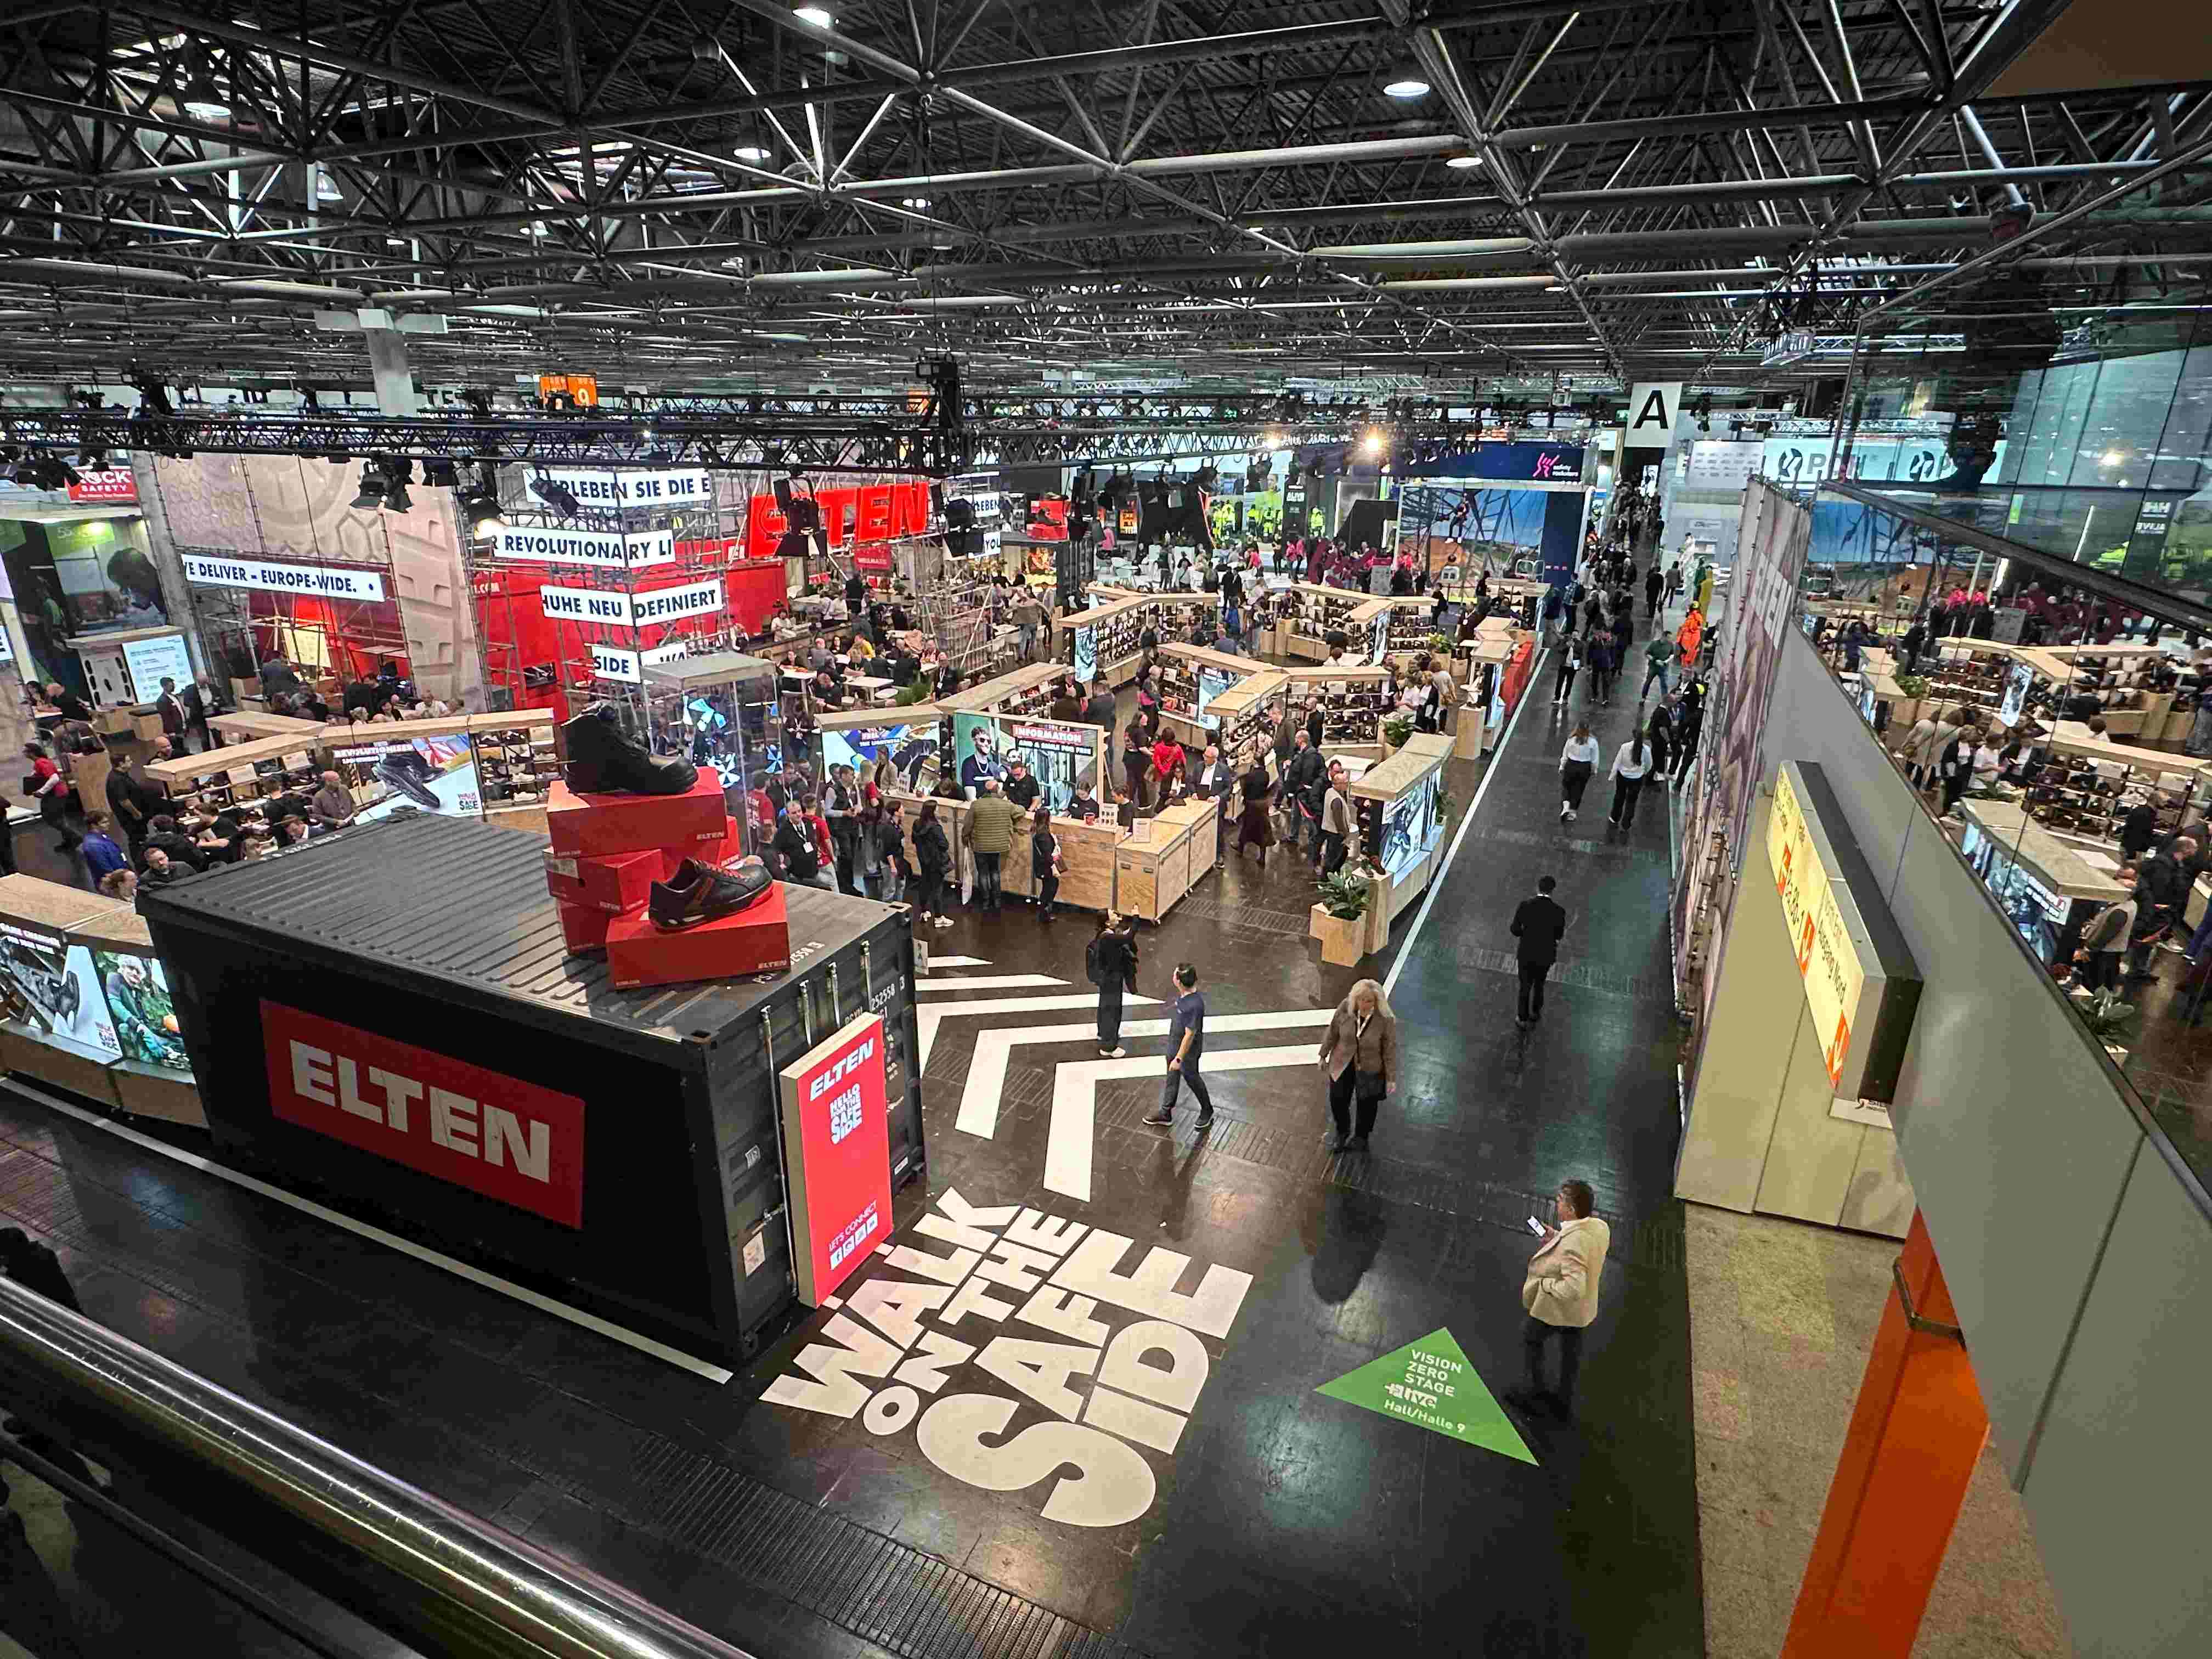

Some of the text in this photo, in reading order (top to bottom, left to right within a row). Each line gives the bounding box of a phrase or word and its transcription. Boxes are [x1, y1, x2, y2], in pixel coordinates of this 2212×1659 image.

[1632, 390, 1669, 430] A
[555, 479, 629, 499] RLEBEN
[636, 479, 662, 499] SIE
[668, 477, 695, 495] DIE
[749, 481, 929, 558] ETEN
[505, 535, 651, 560] REVOLUTIONARY
[659, 539, 672, 556] LI
[198, 563, 247, 582] DELIVER
[261, 569, 357, 592] EUROPE-WIDE.
[589, 600, 622, 617] NEU
[635, 589, 716, 619] DEFINIERT
[593, 656, 629, 674] SIDE
[1014, 726, 1082, 743] INFORMATION
[1076, 747, 1092, 755] FREE
[696, 831, 725, 841] ELTEN
[758, 960, 788, 970] ELTEN
[871, 984, 895, 1011] 252558
[900, 975, 905, 991] 3
[810, 1037, 873, 1101] ELTEN
[290, 1039, 550, 1183] ELTEN
[829, 1083, 860, 1119] HELLO
[829, 1198, 878, 1251] LET'S CONNECT
[759, 1186, 1021, 1418] WALK
[863, 1206, 1090, 1436] ON THE
[1407, 1361, 1448, 1381] ZERO
[1411, 1348, 1462, 1374] VISION
[1404, 1373, 1455, 1397] STAGE
[1384, 1399, 1466, 1433] Hall/Halle 9
